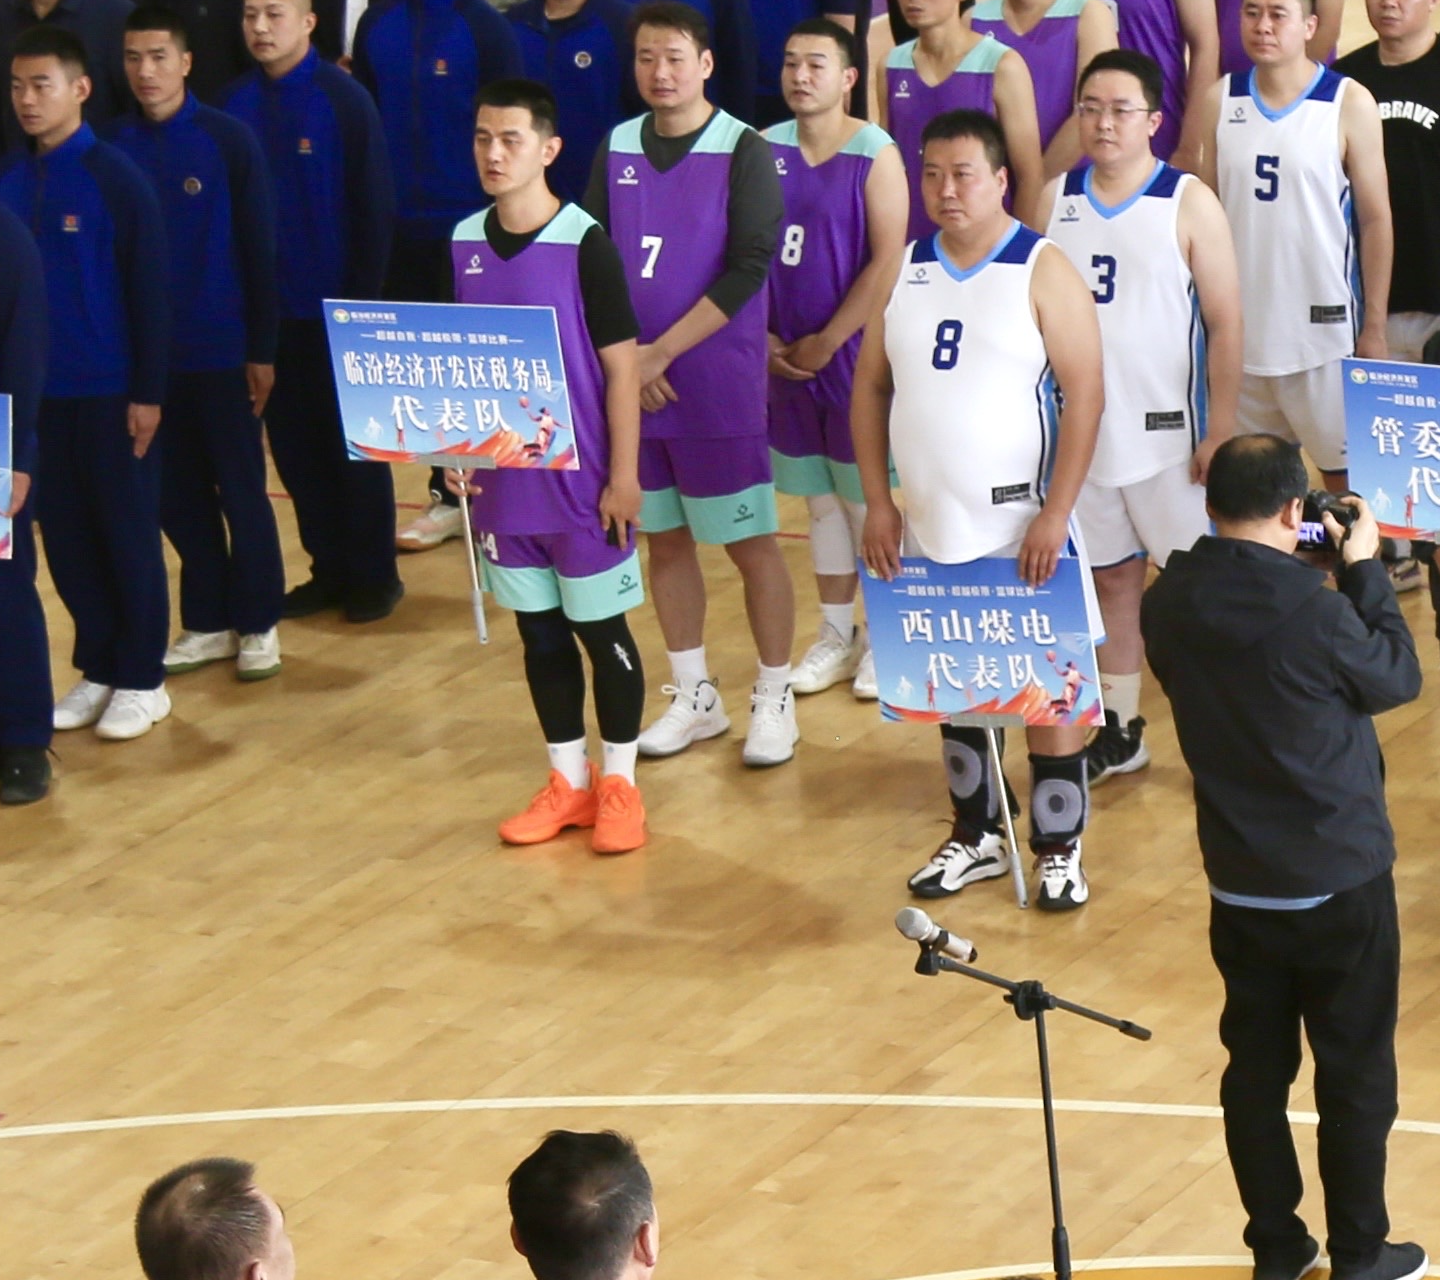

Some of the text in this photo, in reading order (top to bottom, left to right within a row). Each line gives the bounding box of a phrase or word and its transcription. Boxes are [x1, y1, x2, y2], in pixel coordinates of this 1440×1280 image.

[1379, 100, 1440, 130] BRAVE
[1254, 154, 1280, 202] 5
[640, 235, 663, 278] 7
[780, 224, 805, 266] 8
[1091, 254, 1118, 304] 3
[931, 319, 963, 370] 8
[343, 350, 553, 393] 临汾经济开发区税务局
[390, 395, 512, 433] 代表队
[898, 608, 1057, 646] 西山煤电
[927, 652, 1046, 691] 代表队
